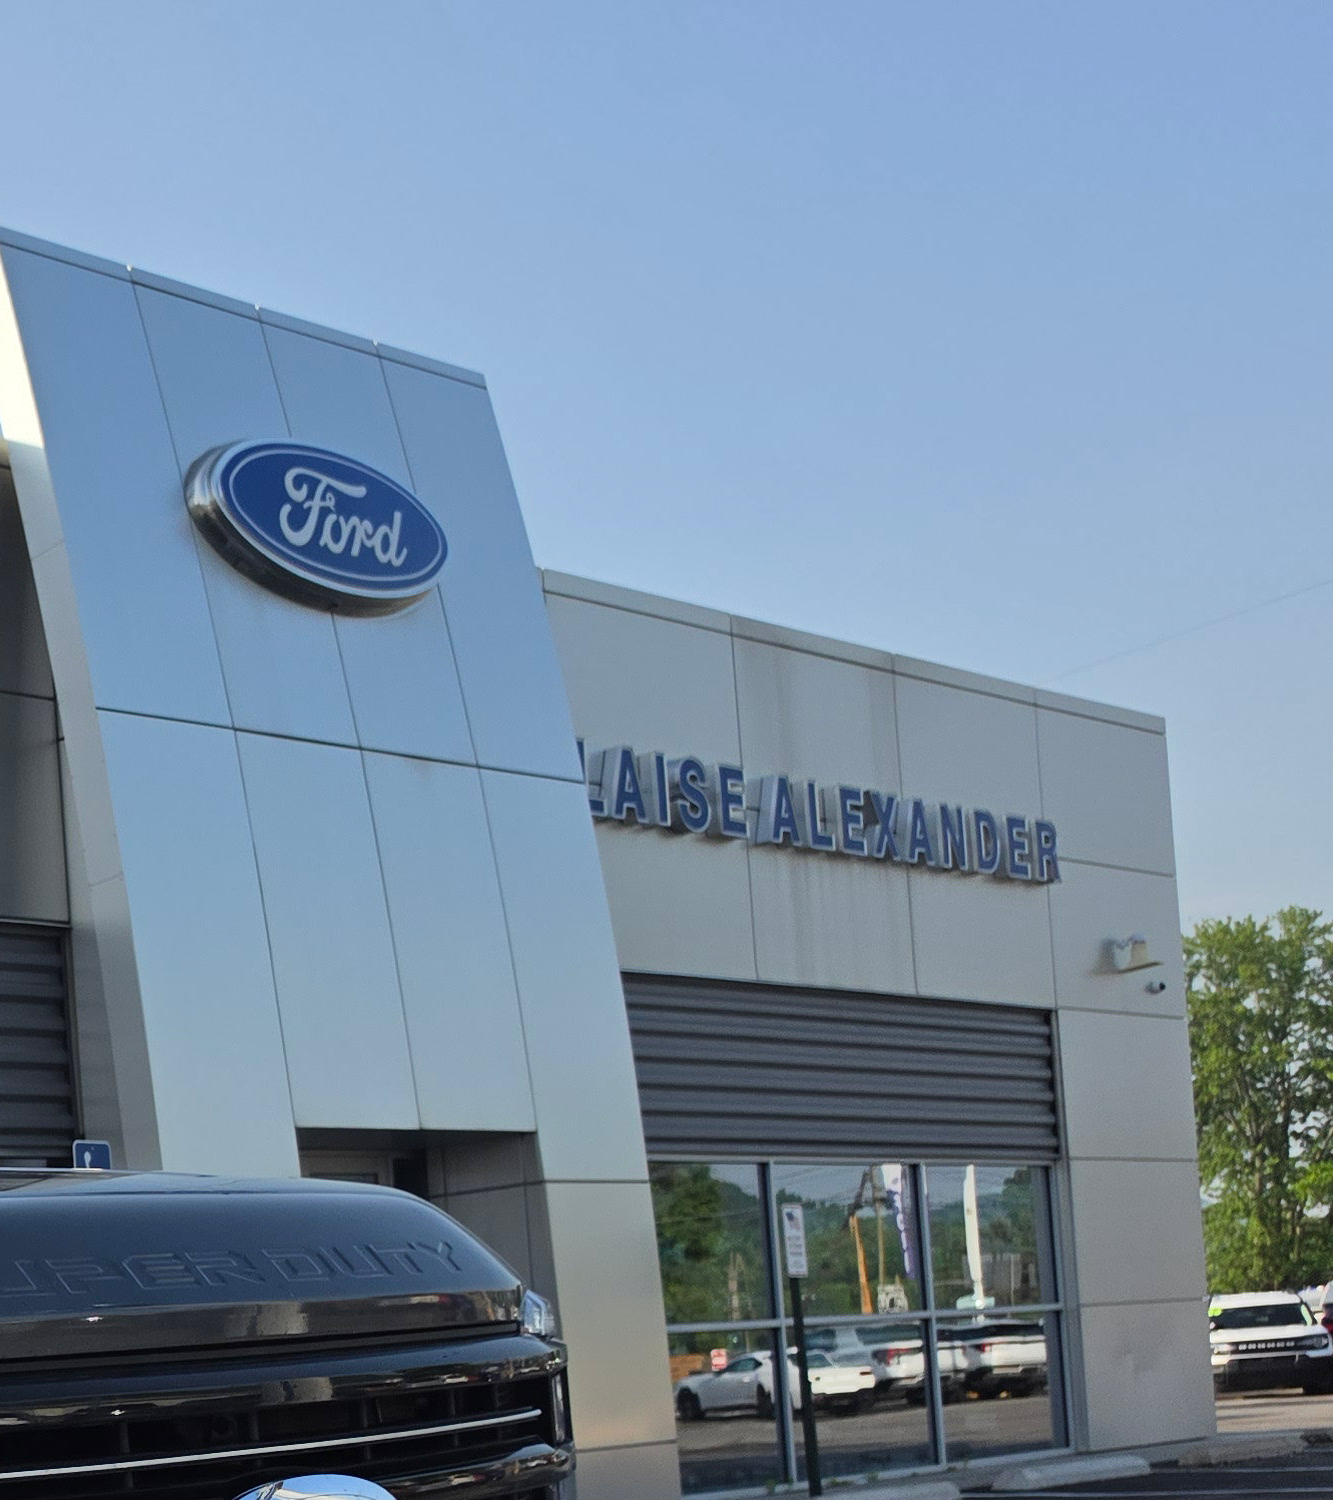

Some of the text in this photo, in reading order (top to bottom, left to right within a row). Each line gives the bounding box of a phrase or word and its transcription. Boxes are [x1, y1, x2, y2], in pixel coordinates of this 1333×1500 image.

[279, 466, 408, 567] Ford
[769, 773, 1061, 884] ALEXANDER
[262, 1240, 465, 1284] DUTY
